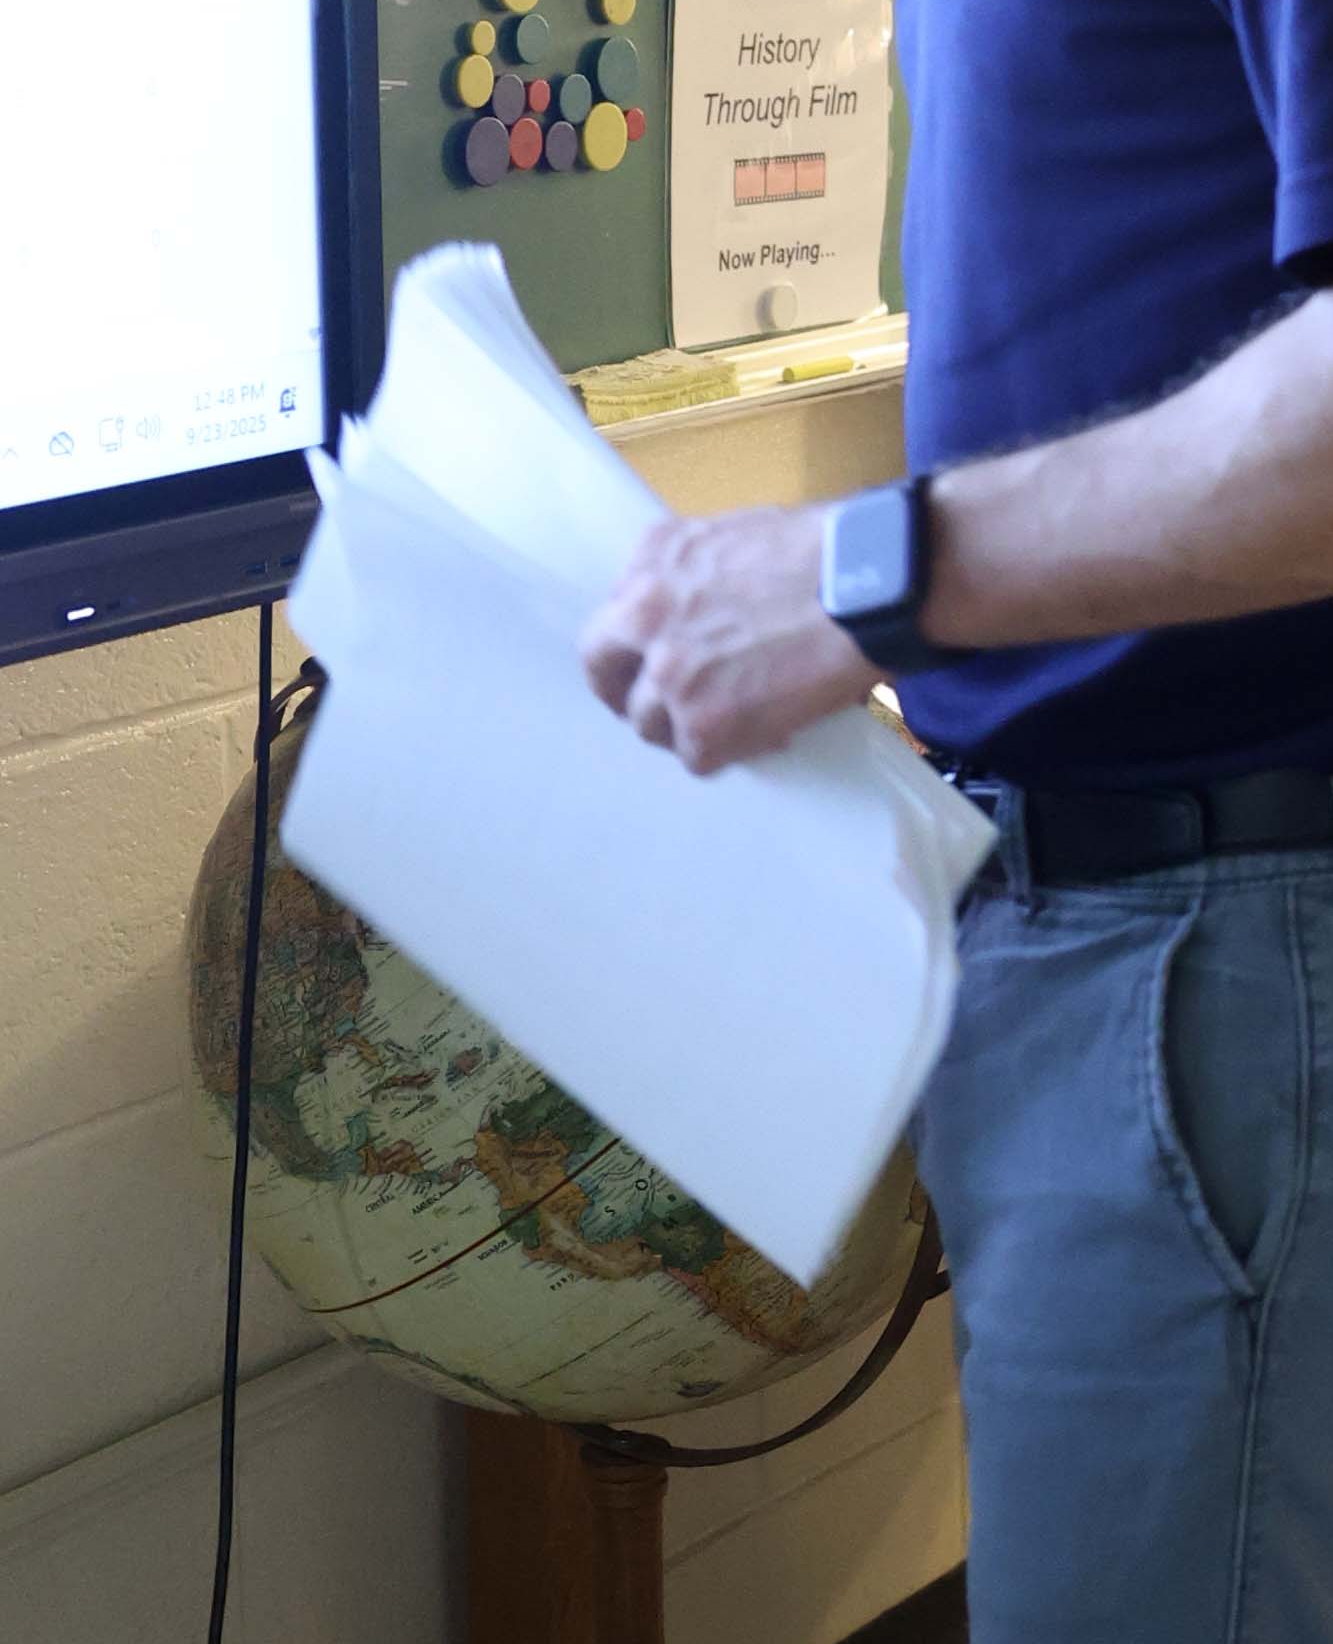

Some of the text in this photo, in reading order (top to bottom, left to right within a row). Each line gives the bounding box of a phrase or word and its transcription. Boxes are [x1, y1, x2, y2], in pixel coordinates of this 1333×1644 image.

[737, 32, 820, 70] History
[704, 84, 858, 129] Through Film
[718, 249, 756, 272] Now
[240, 380, 265, 404] PM
[186, 412, 267, 447] 9/23/2025
